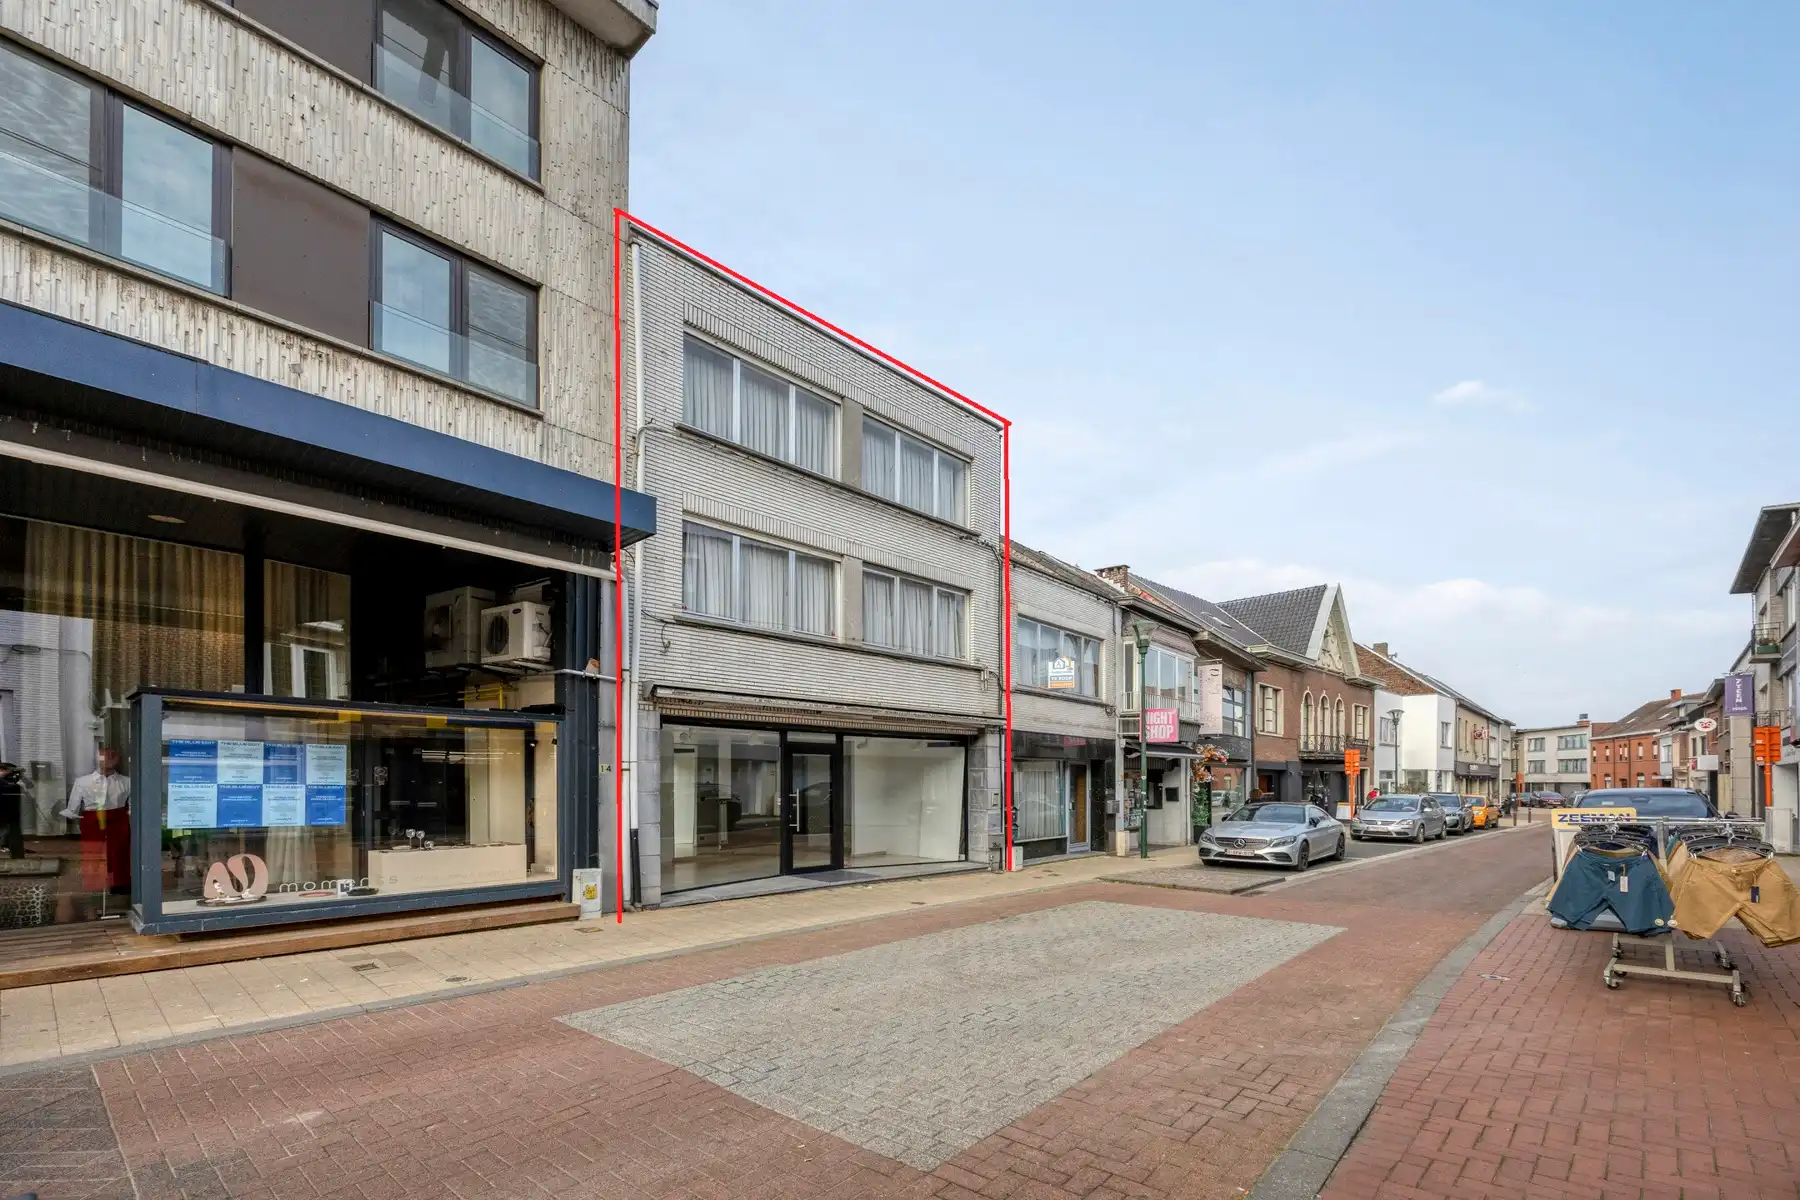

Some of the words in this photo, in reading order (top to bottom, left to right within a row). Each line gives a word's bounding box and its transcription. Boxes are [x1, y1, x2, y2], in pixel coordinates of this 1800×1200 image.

[1144, 711, 1173, 725] NIGHT
[1144, 725, 1174, 739] SHOP
[601, 764, 611, 772] 14
[1558, 813, 1631, 823] ZEEMN
